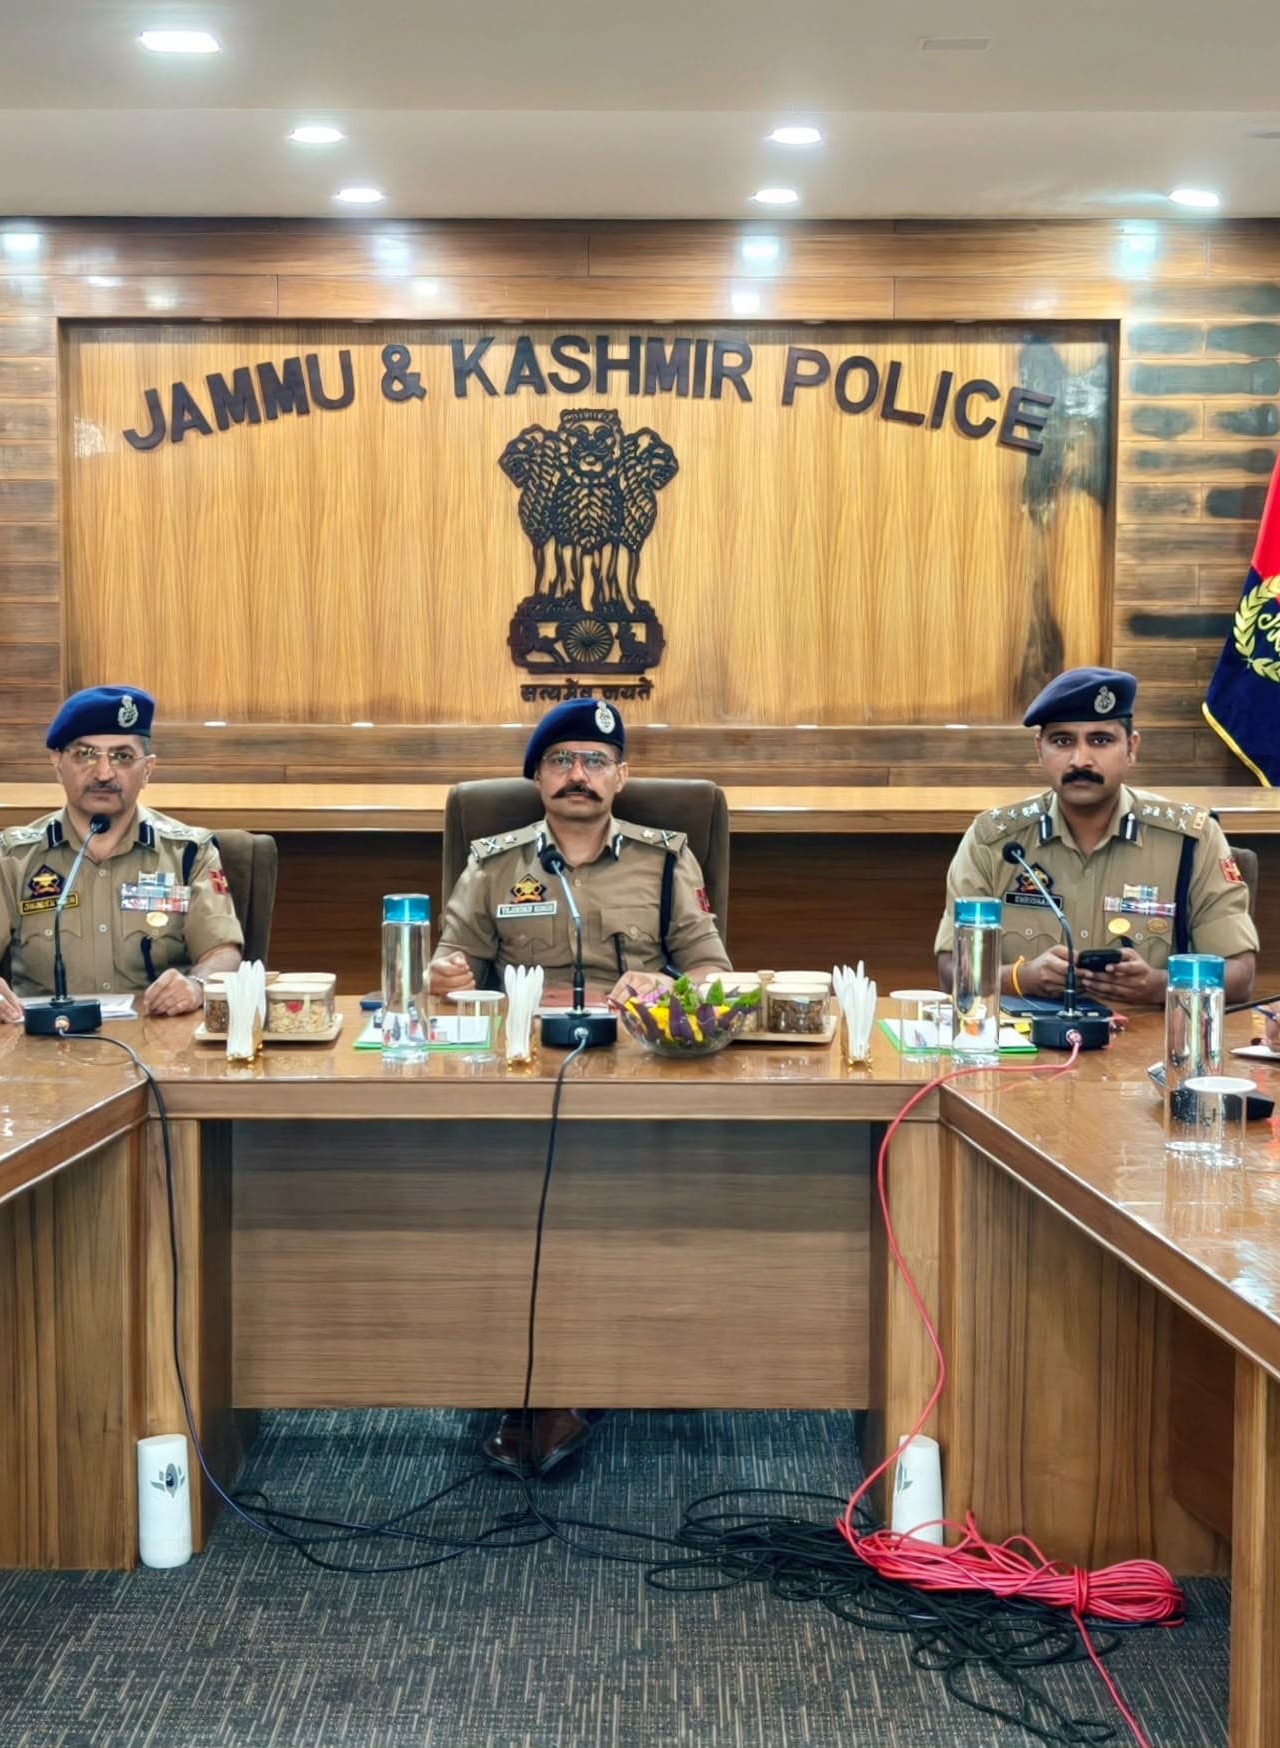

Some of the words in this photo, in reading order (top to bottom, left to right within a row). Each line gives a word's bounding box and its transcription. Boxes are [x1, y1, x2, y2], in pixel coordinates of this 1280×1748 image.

[122, 349, 355, 451] JAMMU
[381, 343, 426, 402] &
[449, 334, 753, 402] KASHMIR
[780, 346, 1056, 456] POLICE
